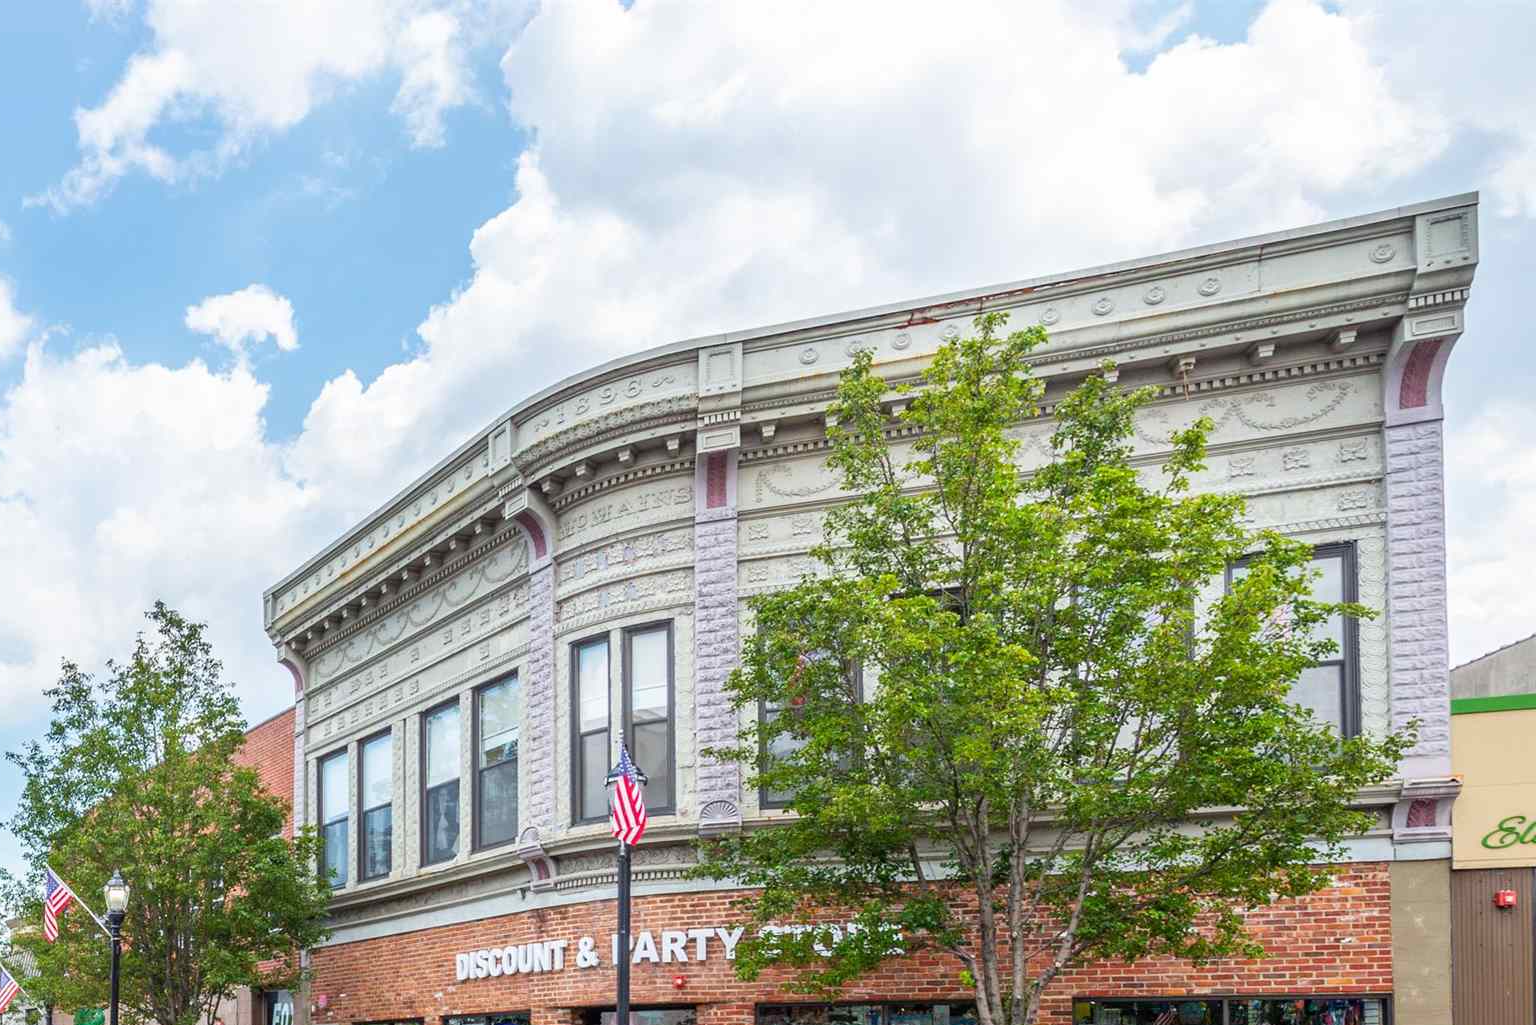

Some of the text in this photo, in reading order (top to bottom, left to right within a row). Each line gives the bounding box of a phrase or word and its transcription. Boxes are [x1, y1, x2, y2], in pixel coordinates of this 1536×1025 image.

[455, 939, 568, 981] DISCOUNT
[576, 936, 600, 969] &
[758, 922, 905, 957] STO
